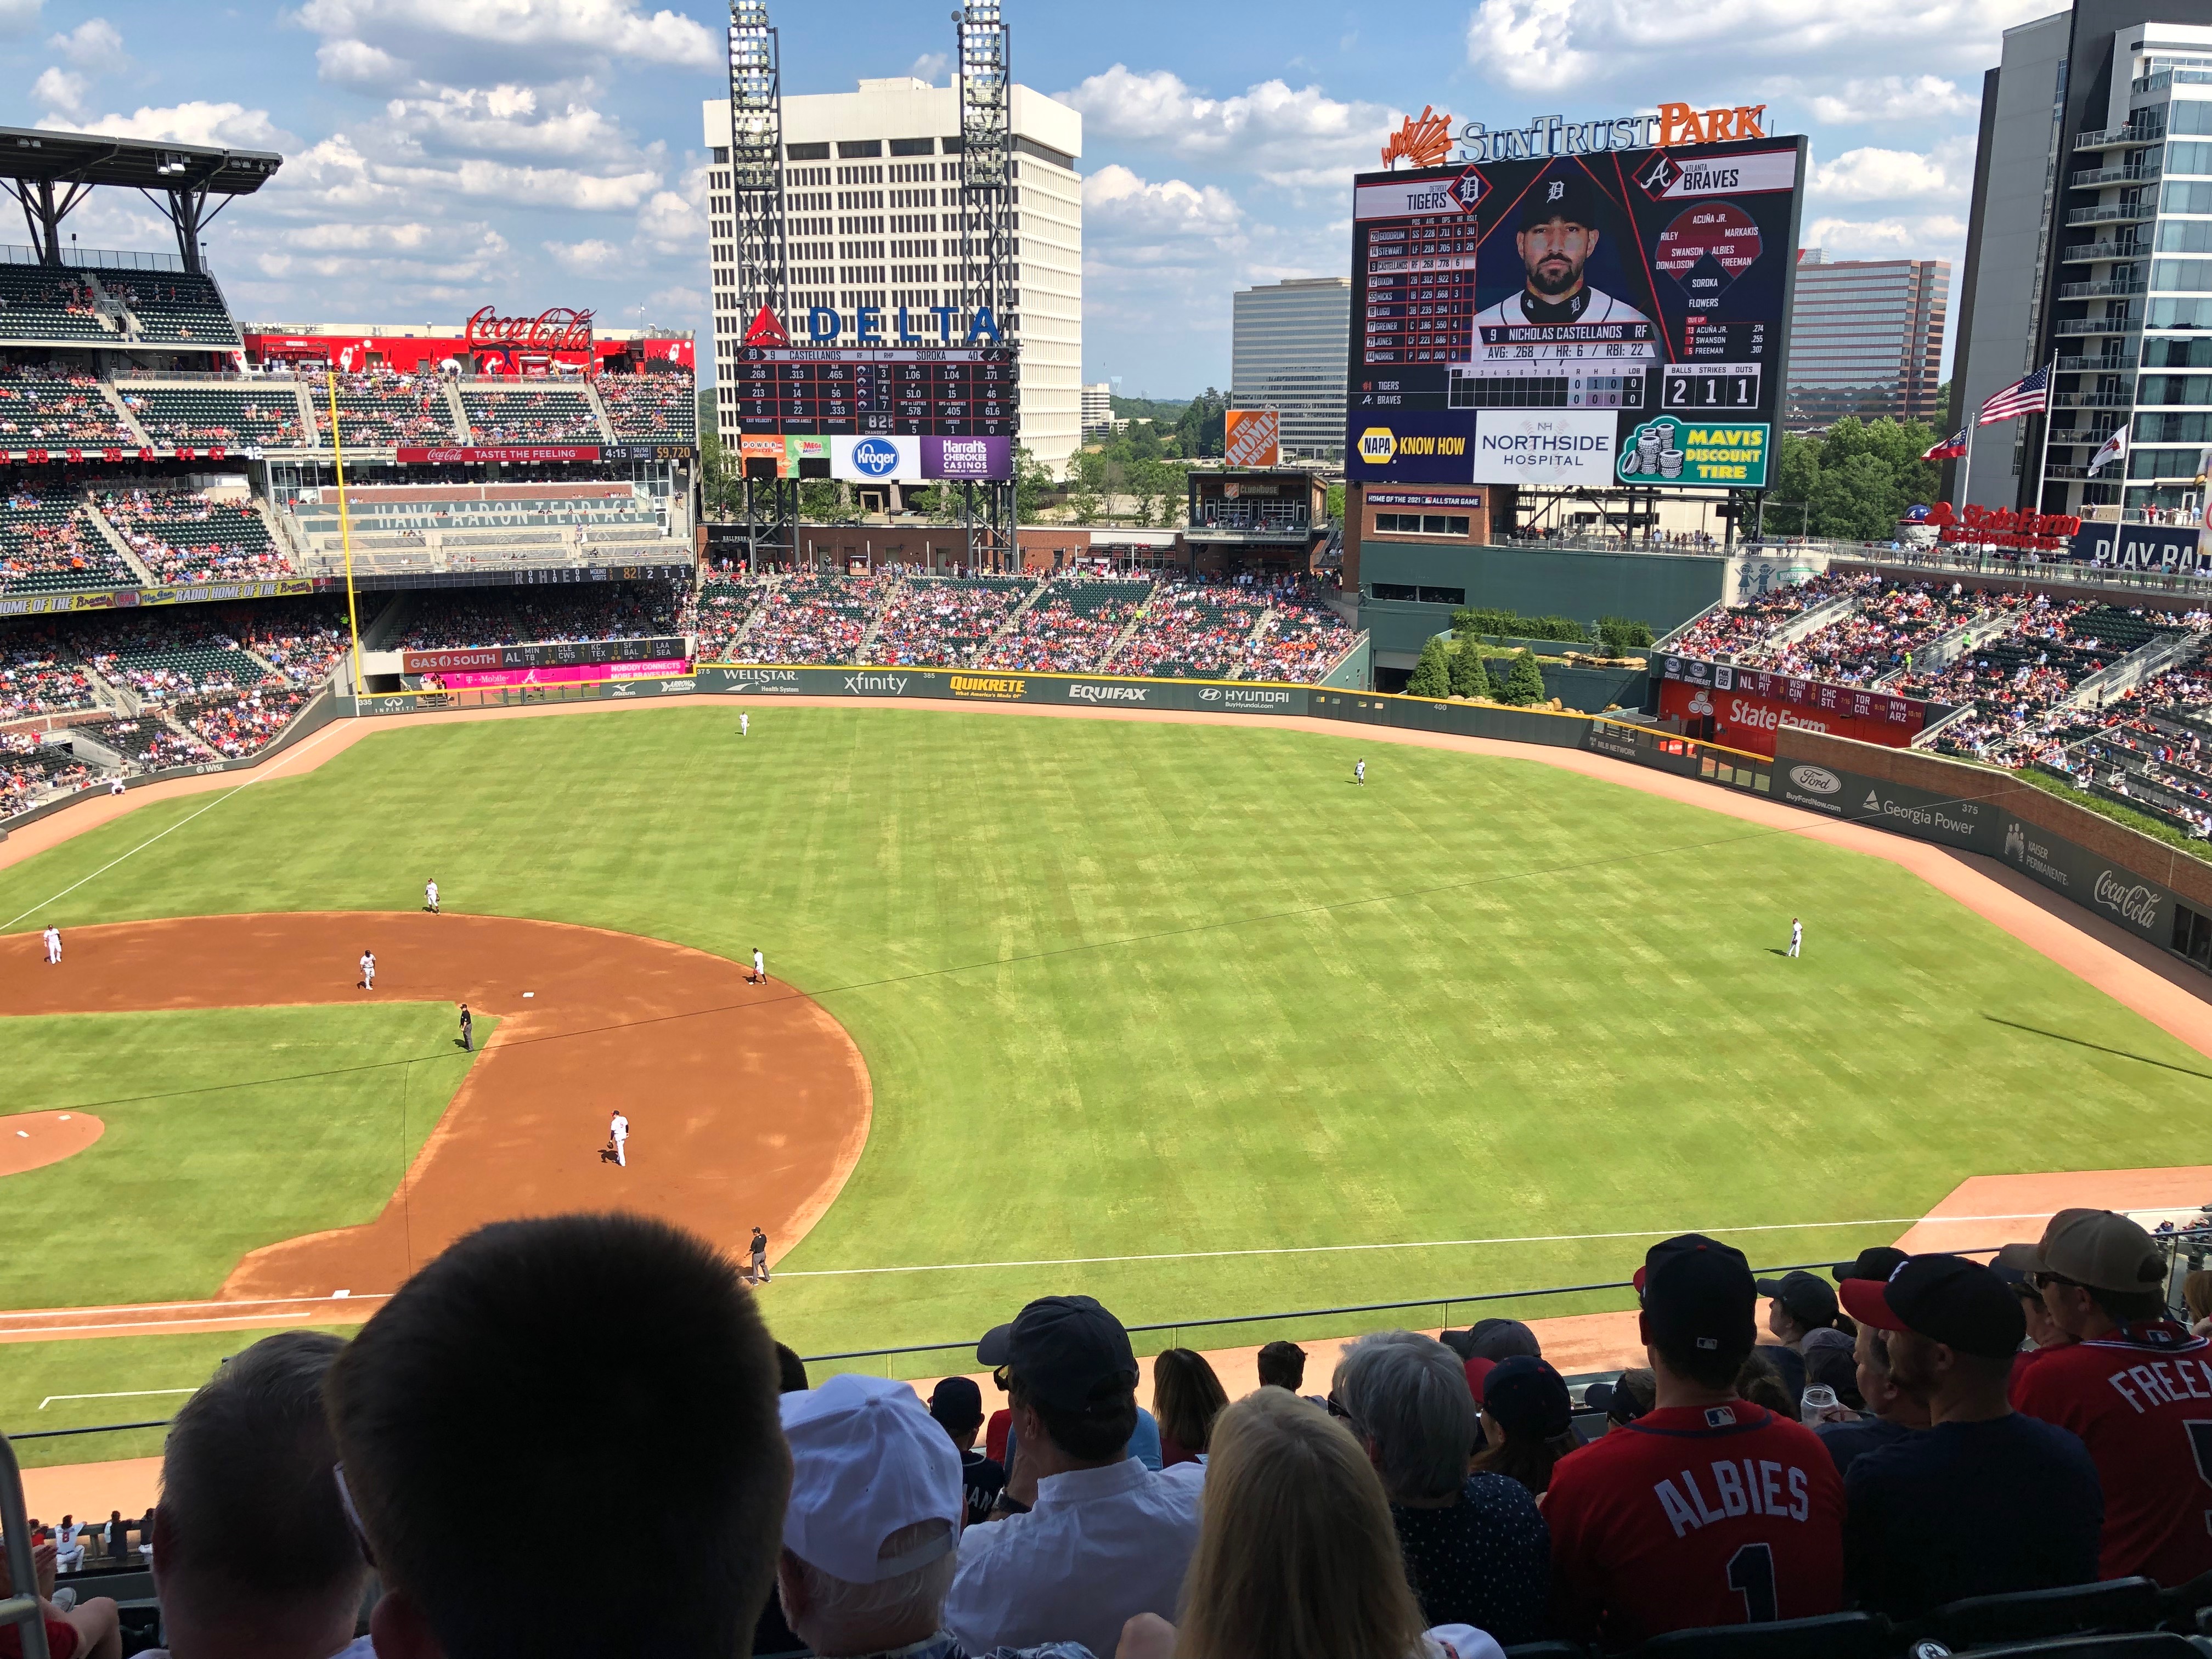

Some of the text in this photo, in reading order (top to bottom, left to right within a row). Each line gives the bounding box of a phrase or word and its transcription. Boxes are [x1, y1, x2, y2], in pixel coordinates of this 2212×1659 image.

[1655, 103, 1767, 146] PARK
[1685, 163, 1707, 172] ATLANTA
[1684, 169, 1739, 190] BRAVES
[1407, 192, 1446, 210] TIGERS
[1692, 213, 1726, 224] ACUÑA JR.
[1380, 231, 1404, 240] GOODRUM
[1661, 232, 1678, 240] RILEY
[1725, 227, 1758, 237] MARKAKIS
[1379, 246, 1402, 256] STEWART
[1672, 247, 1703, 257] SWANSON
[1712, 246, 1734, 255] ALBIES
[1379, 261, 1408, 270] CASTELLANOS
[1656, 260, 1694, 269] DONALDSON
[1722, 257, 1751, 267] FREEMAN
[1378, 277, 1393, 285] DIXON
[1692, 279, 1718, 287] SOROKA
[1377, 292, 1392, 301] HICKS
[1689, 298, 1718, 308] FLOWERS
[810, 306, 1001, 341] DELTA
[1490, 325, 1647, 341] 9 NICHOLAS CASTELLANOS RF
[790, 351, 840, 360] CASTELLANOS
[917, 351, 978, 360] SOROKA 40
[1488, 343, 1643, 358] AVG: .268 HR: 6 RBI: 22
[1673, 380, 1686, 403] 2
[1706, 380, 1716, 403] 1
[1737, 379, 1747, 403] 1
[1231, 417, 1253, 439] THE
[1226, 411, 1278, 466] HOME
[1483, 435, 1609, 450] NORTHSIDE
[1687, 430, 1763, 445] MAVIS
[1246, 431, 1278, 466] DEPOT
[1364, 437, 1465, 455] NAPA KNOW HOW
[27, 448, 48, 463] 29
[67, 449, 84, 462] 31
[103, 448, 122, 462] 35
[139, 448, 154, 461] 41
[176, 447, 195, 461] 44
[208, 447, 225, 460] 47
[245, 446, 262, 460] 42
[606, 449, 627, 458] 4:15
[657, 447, 690, 459] $9,720
[857, 443, 896, 472] Kroger
[1685, 449, 1762, 462] DISCOUNT
[1504, 455, 1583, 466] HOSPITAL
[1697, 465, 1747, 479] TIRE
[1240, 485, 1277, 493] CLUBHOUSE
[375, 499, 644, 528] HANK AARON TERRACE
[1942, 530, 2060, 550] NEIGHBORHOOD
[175, 583, 277, 602] RADIO HOME OF THE
[411, 654, 495, 668] GAS SOUTH
[505, 653, 521, 663] AL
[611, 664, 641, 672] NOBODY
[723, 669, 795, 682] WELLSTAR
[1684, 675, 1711, 686] SOUTHEAST
[1759, 674, 1772, 683] MIL
[844, 672, 907, 695] xfinity
[950, 676, 1025, 692] QUIKRETE
[1740, 676, 1754, 690] NL
[1758, 681, 1770, 691] PIT
[1790, 680, 1805, 690] WSH
[1069, 684, 1147, 702] EQUIFAX
[1226, 690, 1289, 703] HYUNDAI
[1789, 689, 1802, 698] CIN
[1822, 689, 1836, 698] CHC
[1855, 694, 1870, 705] TOR
[1821, 698, 1835, 708] STL
[1855, 704, 1870, 715] COL
[1891, 701, 1906, 712] NYM
[1889, 712, 1906, 723] ARZ
[205, 764, 225, 772] WISE
[1800, 770, 1830, 789] Ford
[1786, 792, 1841, 812] BuyFordNow.com
[1962, 804, 1978, 814] 375
[1884, 800, 1974, 835] Georgia Power
[2028, 840, 2048, 859] KAISER
[2027, 855, 2067, 886] PERMANENTE
[1654, 1459, 1809, 1538] ALBIES
[1726, 1543, 1778, 1621] 1
